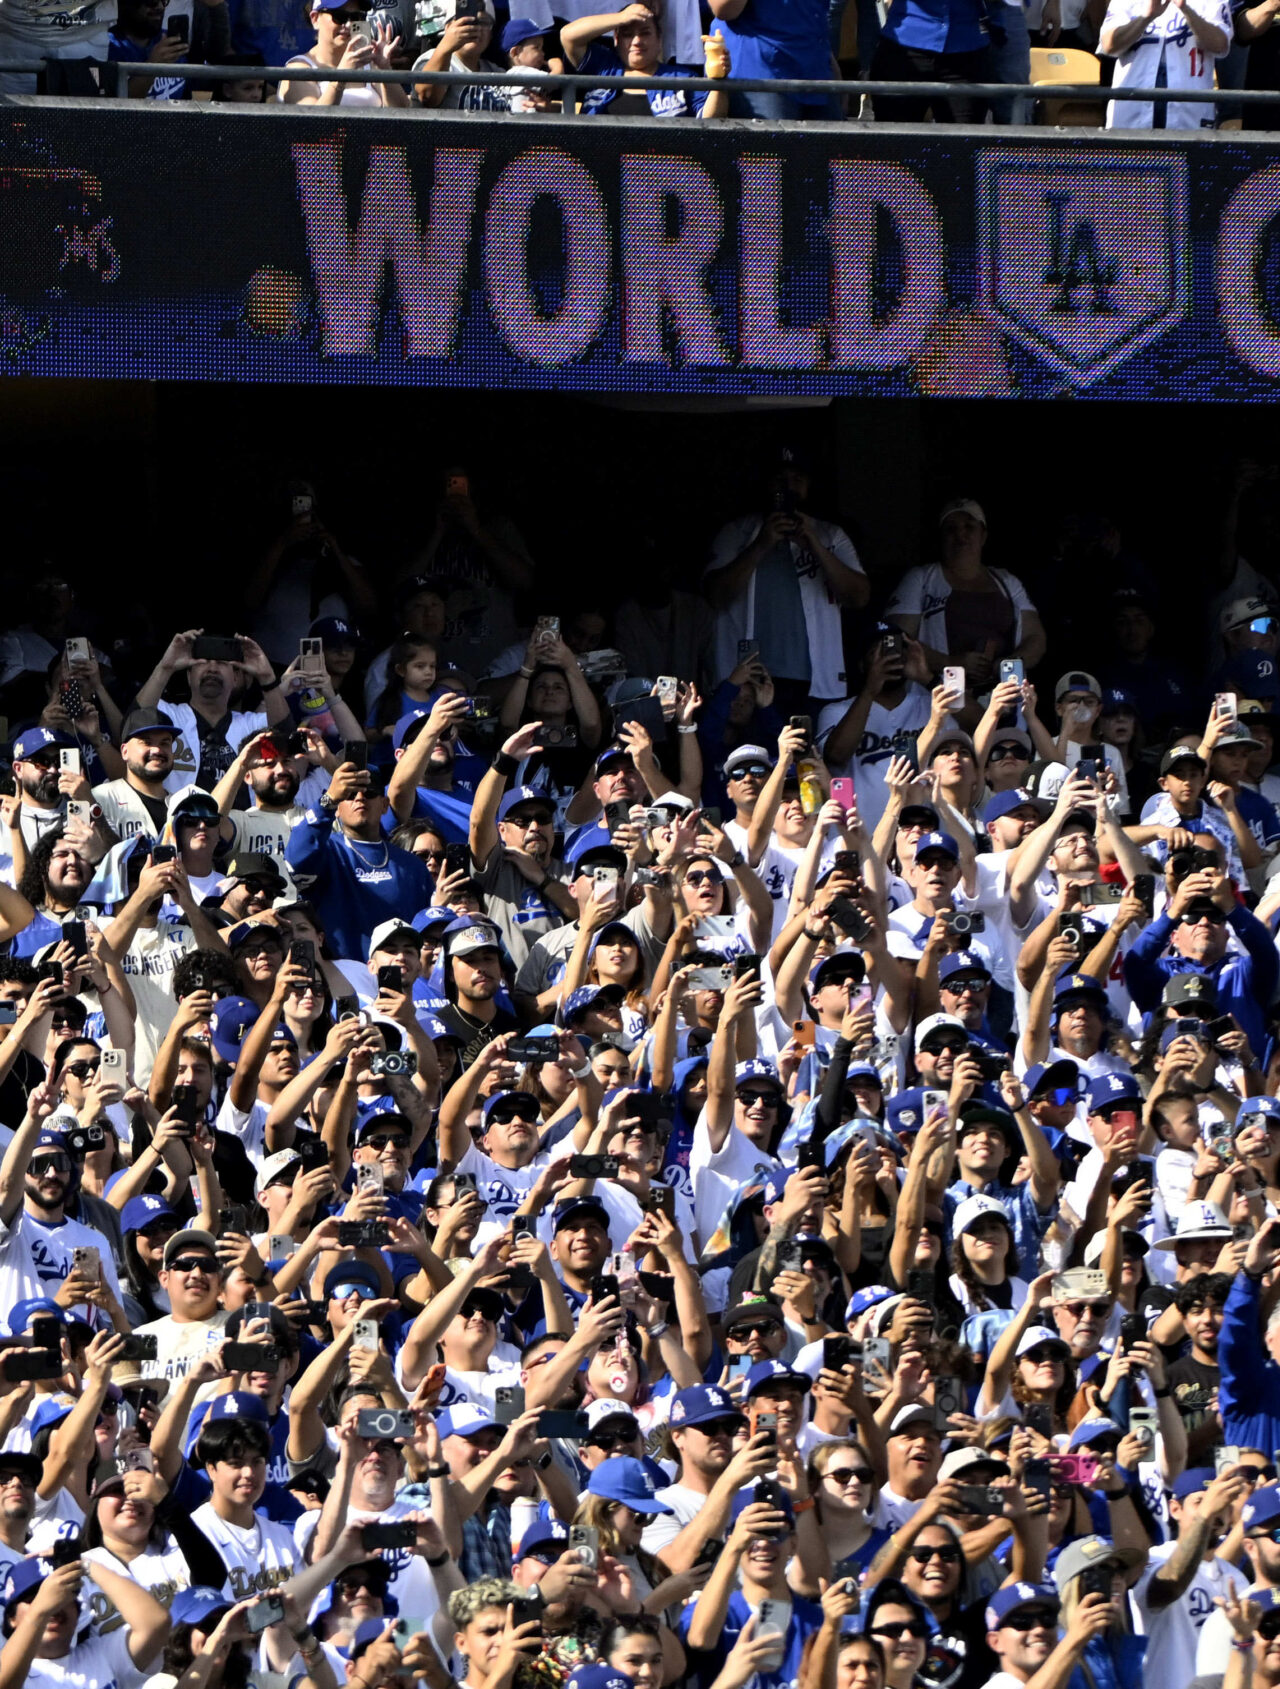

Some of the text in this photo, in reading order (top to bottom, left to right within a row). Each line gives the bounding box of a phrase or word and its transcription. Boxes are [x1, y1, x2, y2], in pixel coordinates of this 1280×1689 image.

[1189, 48, 1206, 77] 17
[291, 142, 945, 370] WORLD
[1043, 188, 1122, 316] LA
[1258, 661, 1273, 677] D
[1113, 690, 1124, 700] LA
[41, 728, 55, 741] LA
[520, 786, 534, 798] LA
[1015, 789, 1029, 800] LA
[929, 832, 942, 844] LA
[356, 868, 392, 883] Dodgers
[1082, 917, 1098, 932] LA
[166, 930, 185, 943] 17
[122, 955, 142, 974] OS
[958, 952, 971, 965] LA
[1072, 975, 1084, 987] LA
[431, 1020, 446, 1033] LA
[1107, 1075, 1124, 1090] LA
[1258, 1099, 1272, 1111] LA
[142, 1196, 160, 1209] LA
[975, 1198, 990, 1211] LA
[1203, 1203, 1218, 1224] LA
[771, 1360, 786, 1373] LA
[224, 1395, 238, 1413] LA
[705, 1388, 723, 1406] LA
[551, 1522, 566, 1538] LA
[36, 1556, 55, 1578] LA
[1015, 1582, 1035, 1599] LA
